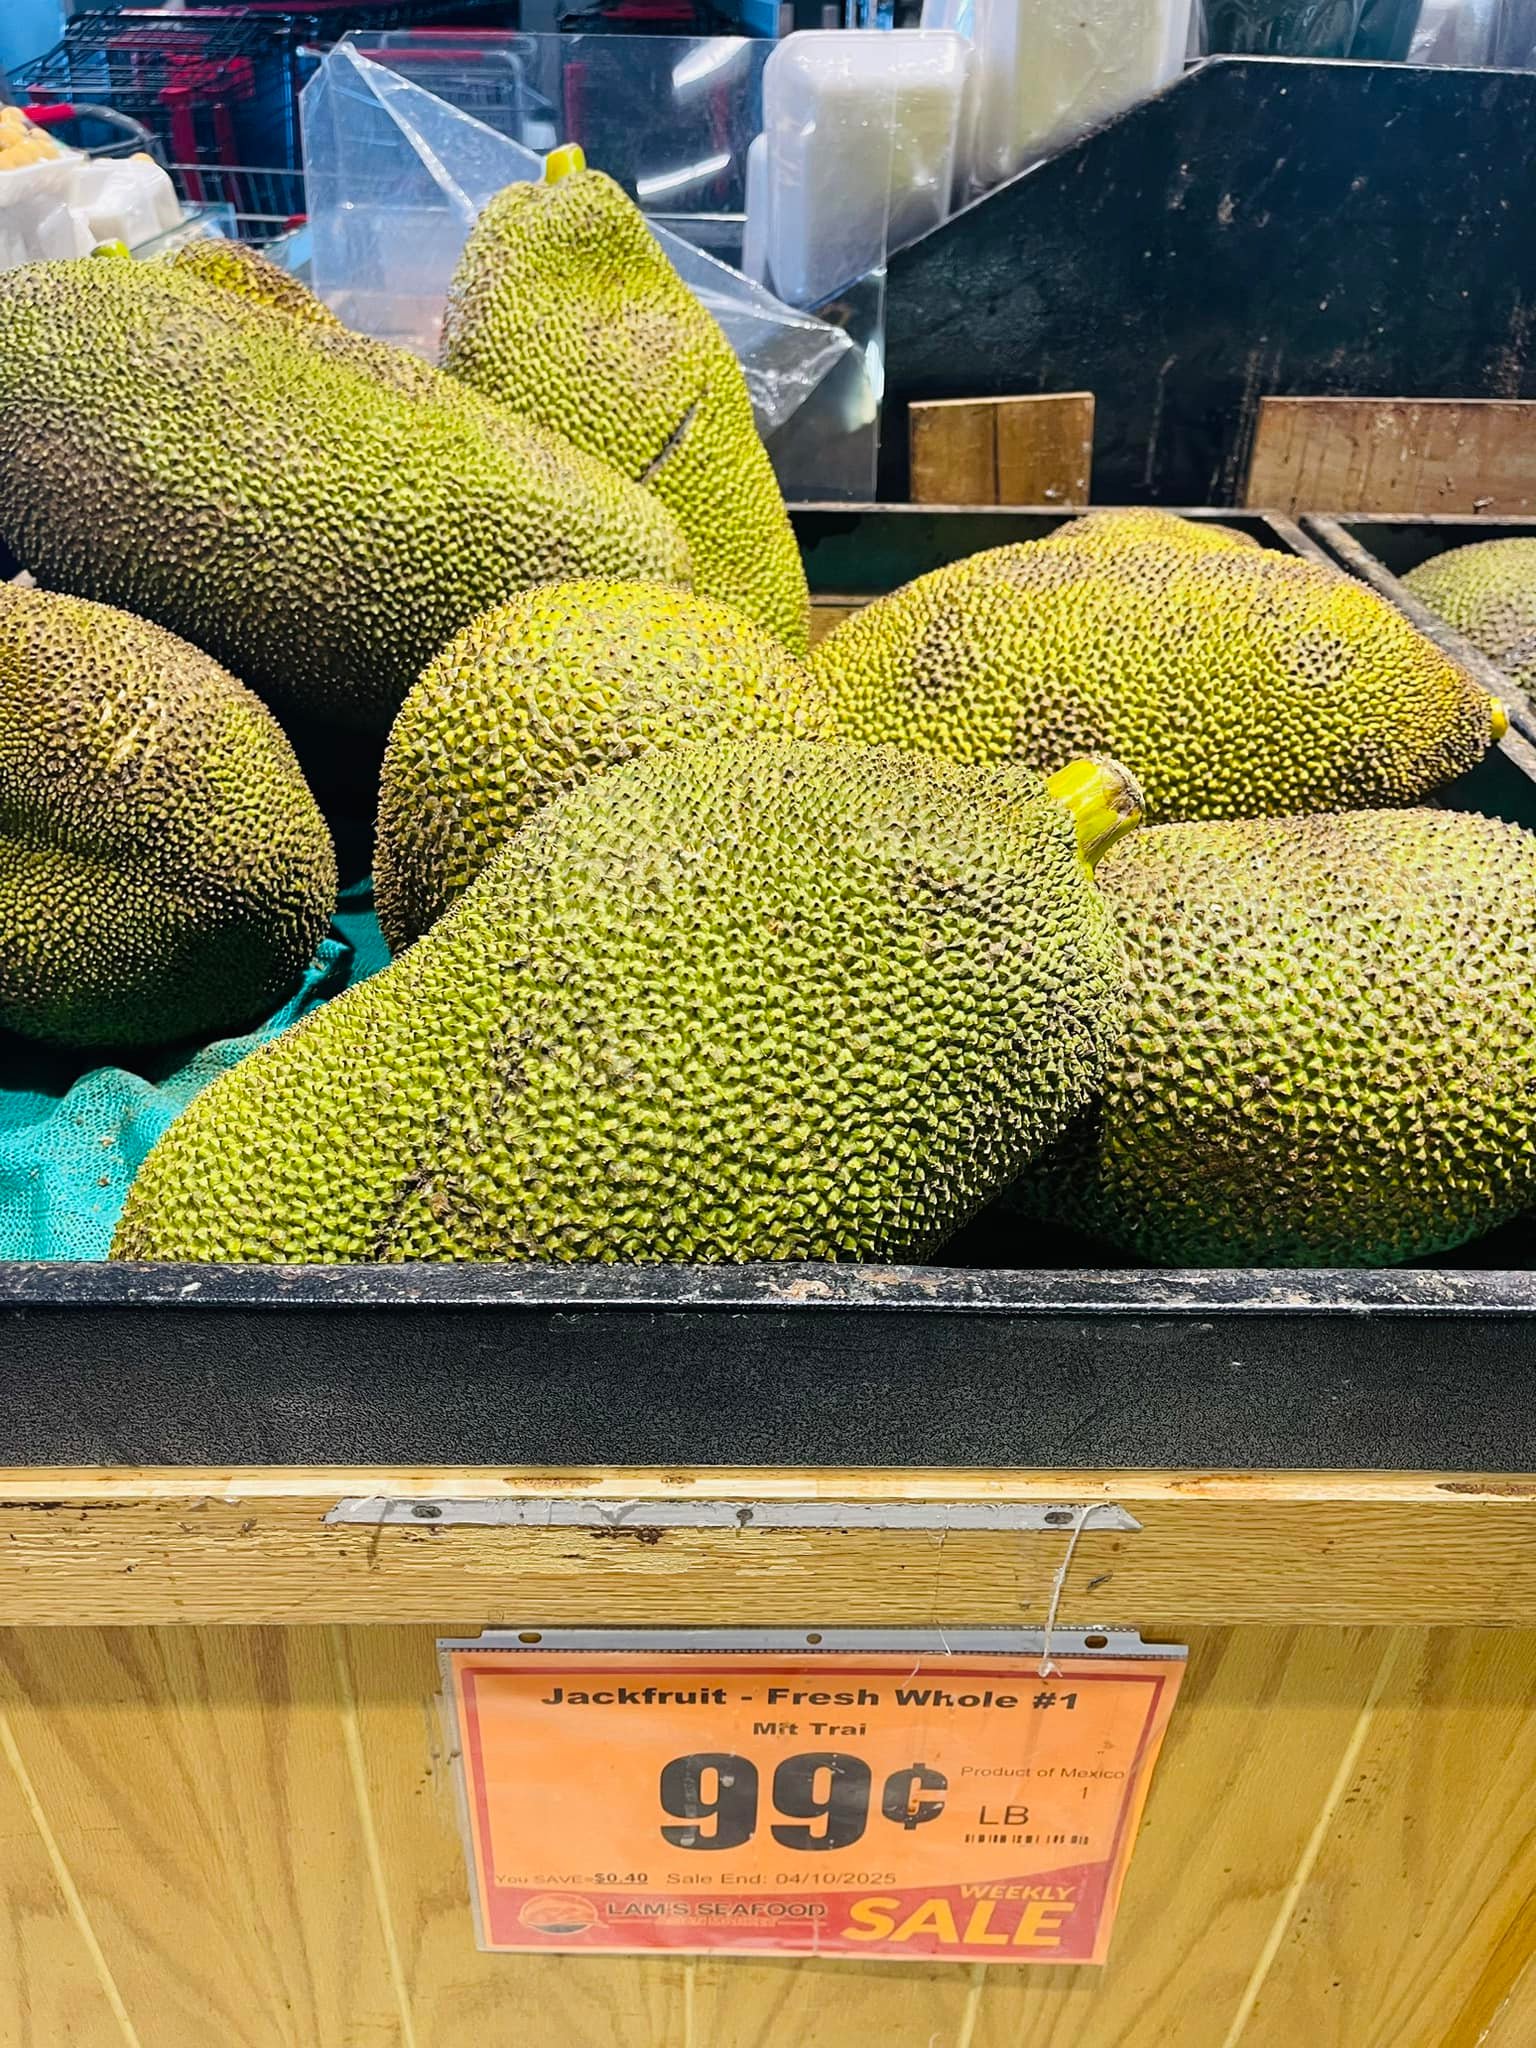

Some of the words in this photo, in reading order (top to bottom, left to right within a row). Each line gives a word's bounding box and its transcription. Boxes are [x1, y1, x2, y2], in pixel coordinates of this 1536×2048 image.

[540, 1687, 727, 1706] Jackfruit
[767, 1687, 879, 1706] Fresh
[895, 1688, 1018, 1708] Whole
[1031, 1692, 1079, 1710] #1
[753, 1722, 798, 1736] Mit
[809, 1722, 867, 1736] Trai
[960, 1765, 1032, 1778] Product
[1037, 1767, 1055, 1778] of
[1060, 1767, 1126, 1780] Mexico
[979, 1805, 1029, 1826] LB
[495, 1874, 528, 1885] You
[666, 1873, 713, 1885] Sale
[720, 1873, 768, 1885] End:
[775, 1872, 897, 1885] 04/10/2025
[959, 1883, 1077, 1901] WEEKLY
[697, 1902, 827, 1917] SEAFOOD
[839, 1896, 1076, 1947] SALE
